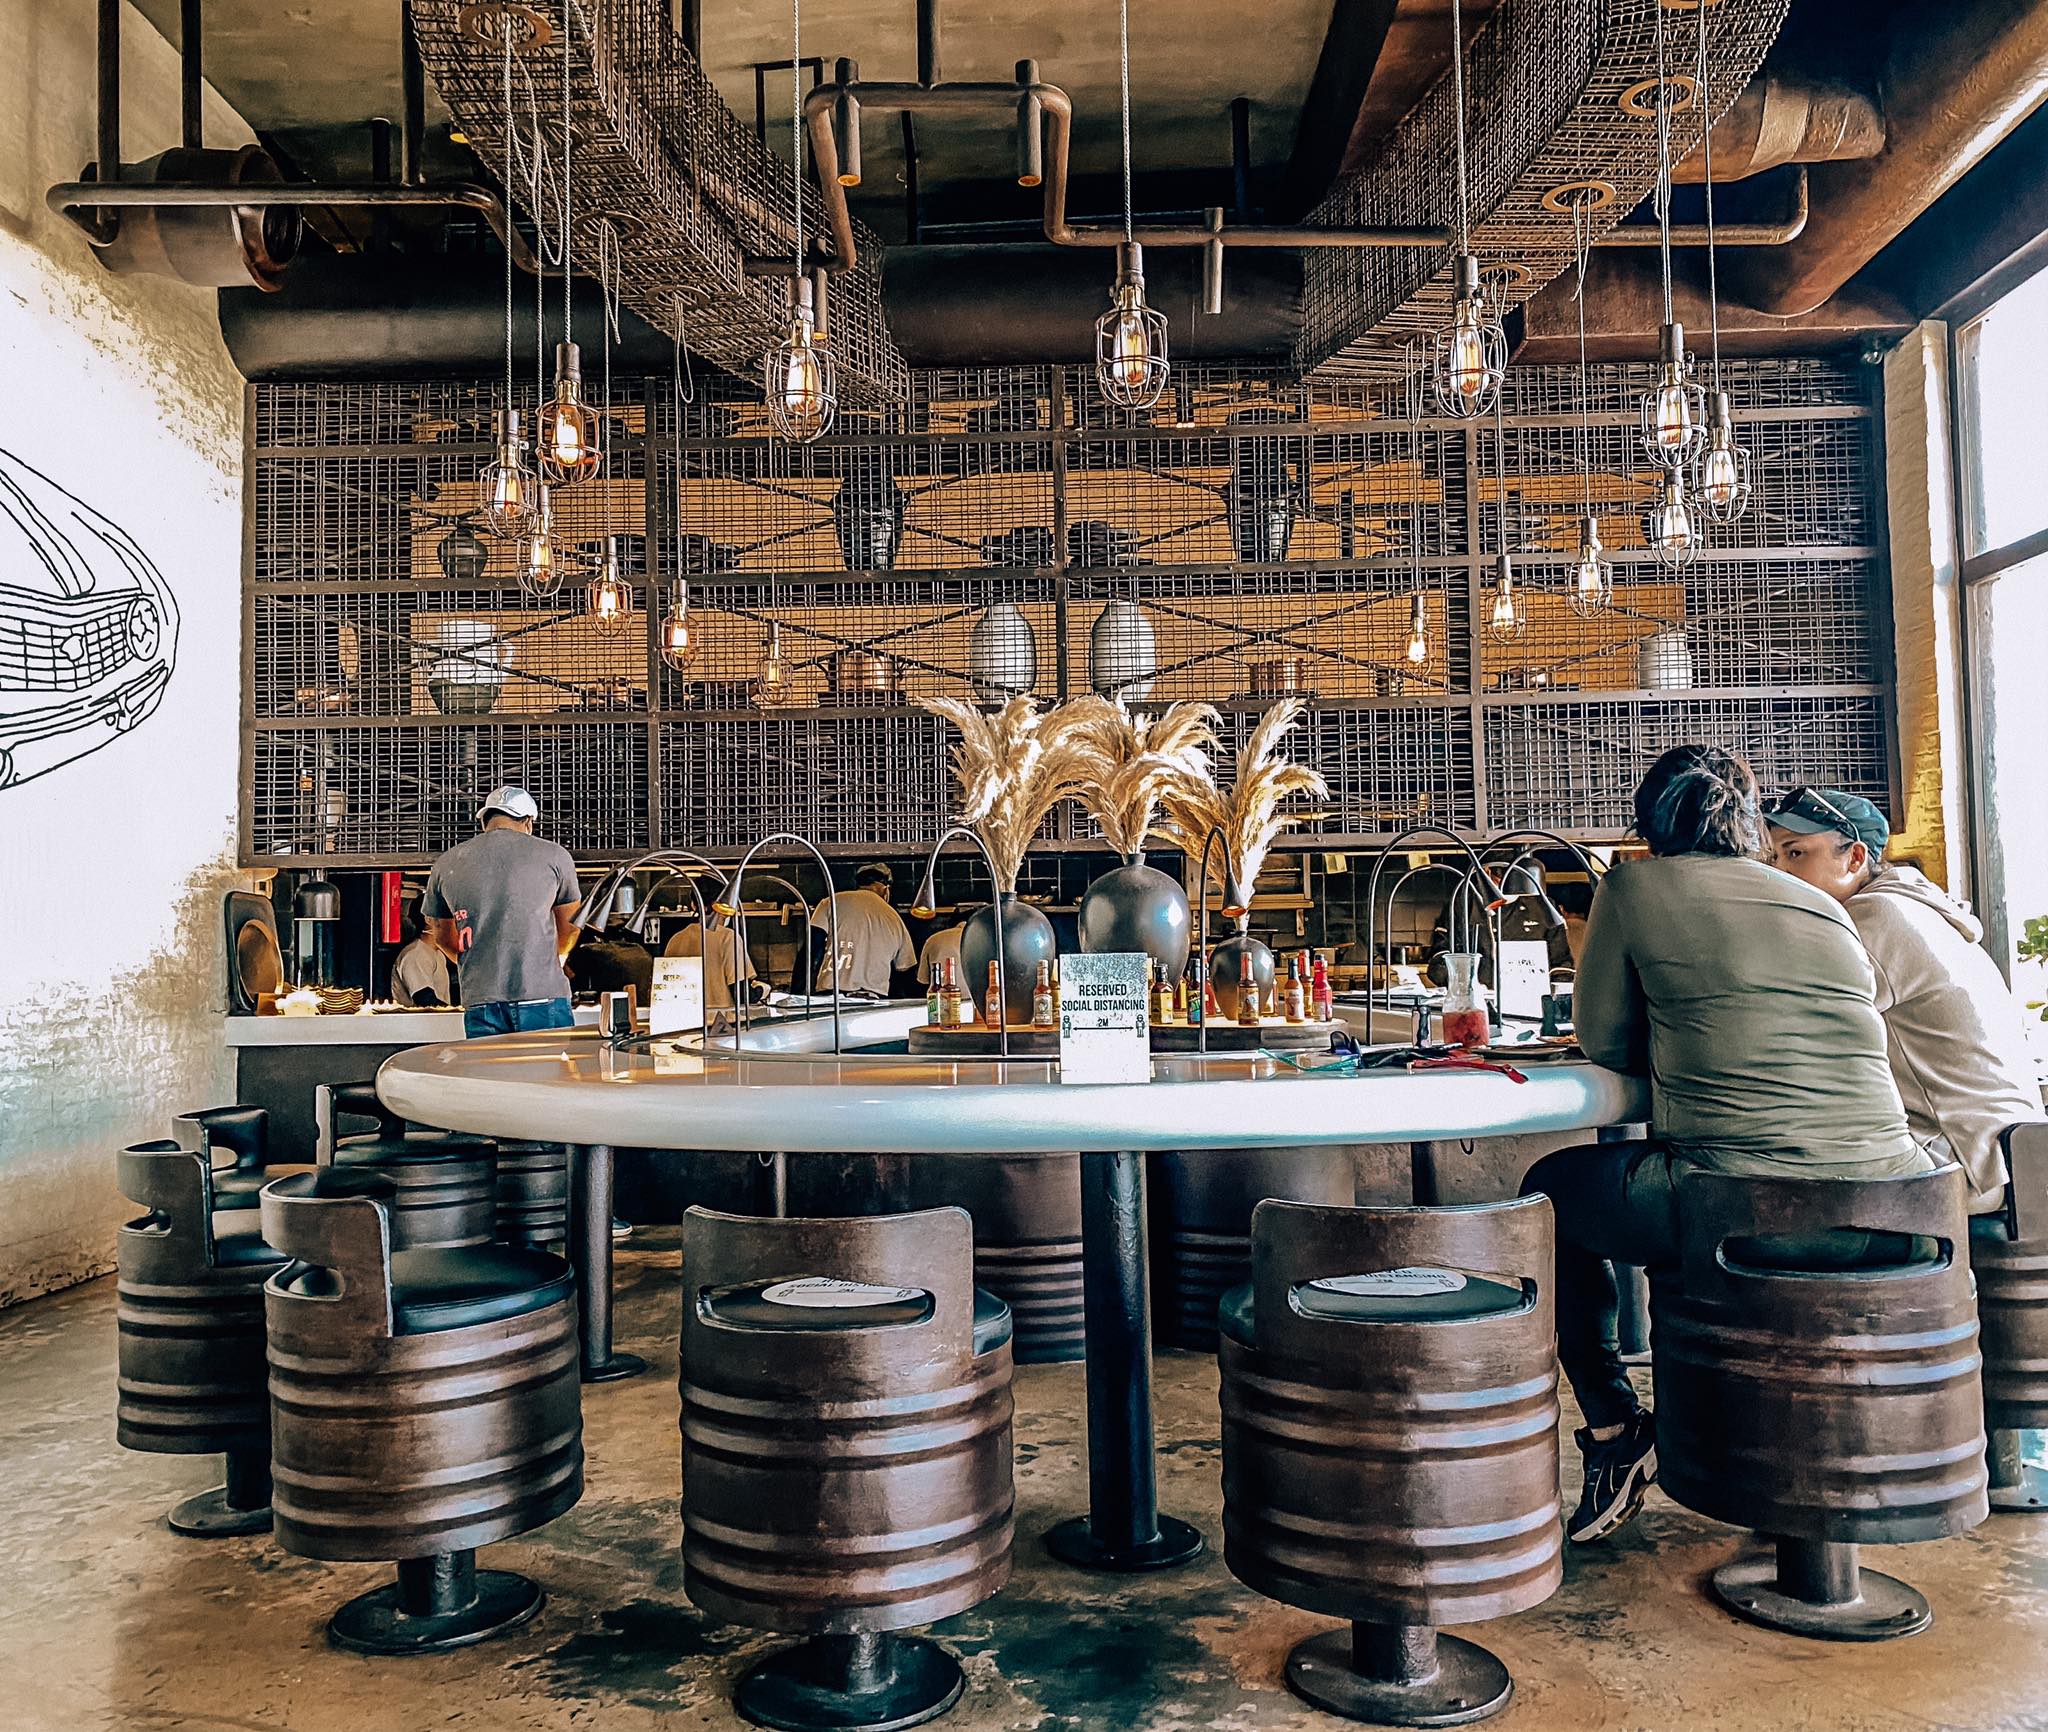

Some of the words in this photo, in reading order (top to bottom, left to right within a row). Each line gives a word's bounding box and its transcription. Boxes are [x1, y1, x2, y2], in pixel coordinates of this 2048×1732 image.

[1079, 984, 1127, 997] RESERVED
[1062, 1000, 1092, 1011] SOCIAL
[1094, 999, 1145, 1011] DISTANCING
[1097, 1018, 1109, 1027] 2M
